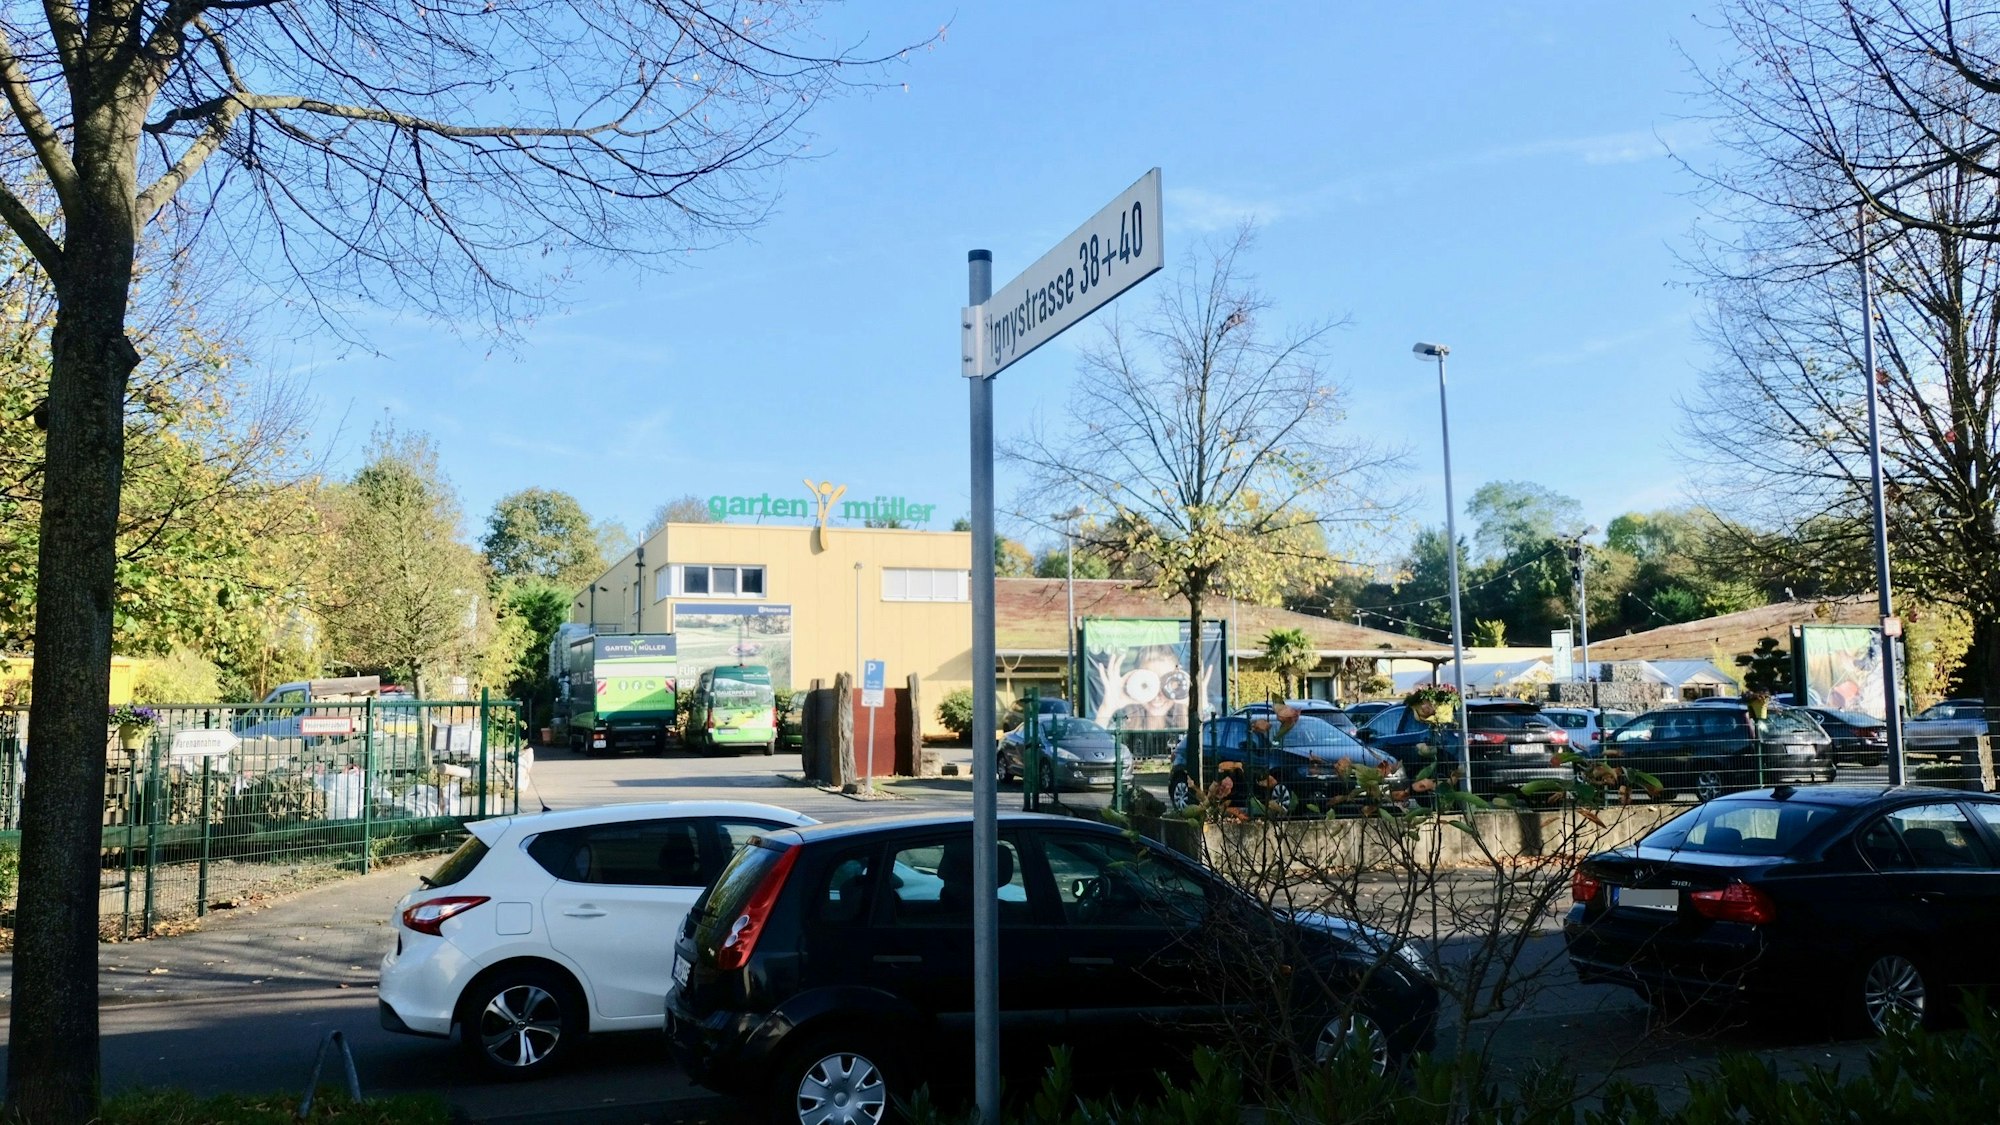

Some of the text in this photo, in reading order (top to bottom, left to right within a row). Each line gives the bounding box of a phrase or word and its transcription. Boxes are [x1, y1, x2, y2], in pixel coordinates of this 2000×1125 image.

[990, 201, 1143, 365] Ignystrasse 38+40
[708, 493, 936, 522] garten müller
[867, 662, 876, 675] P
